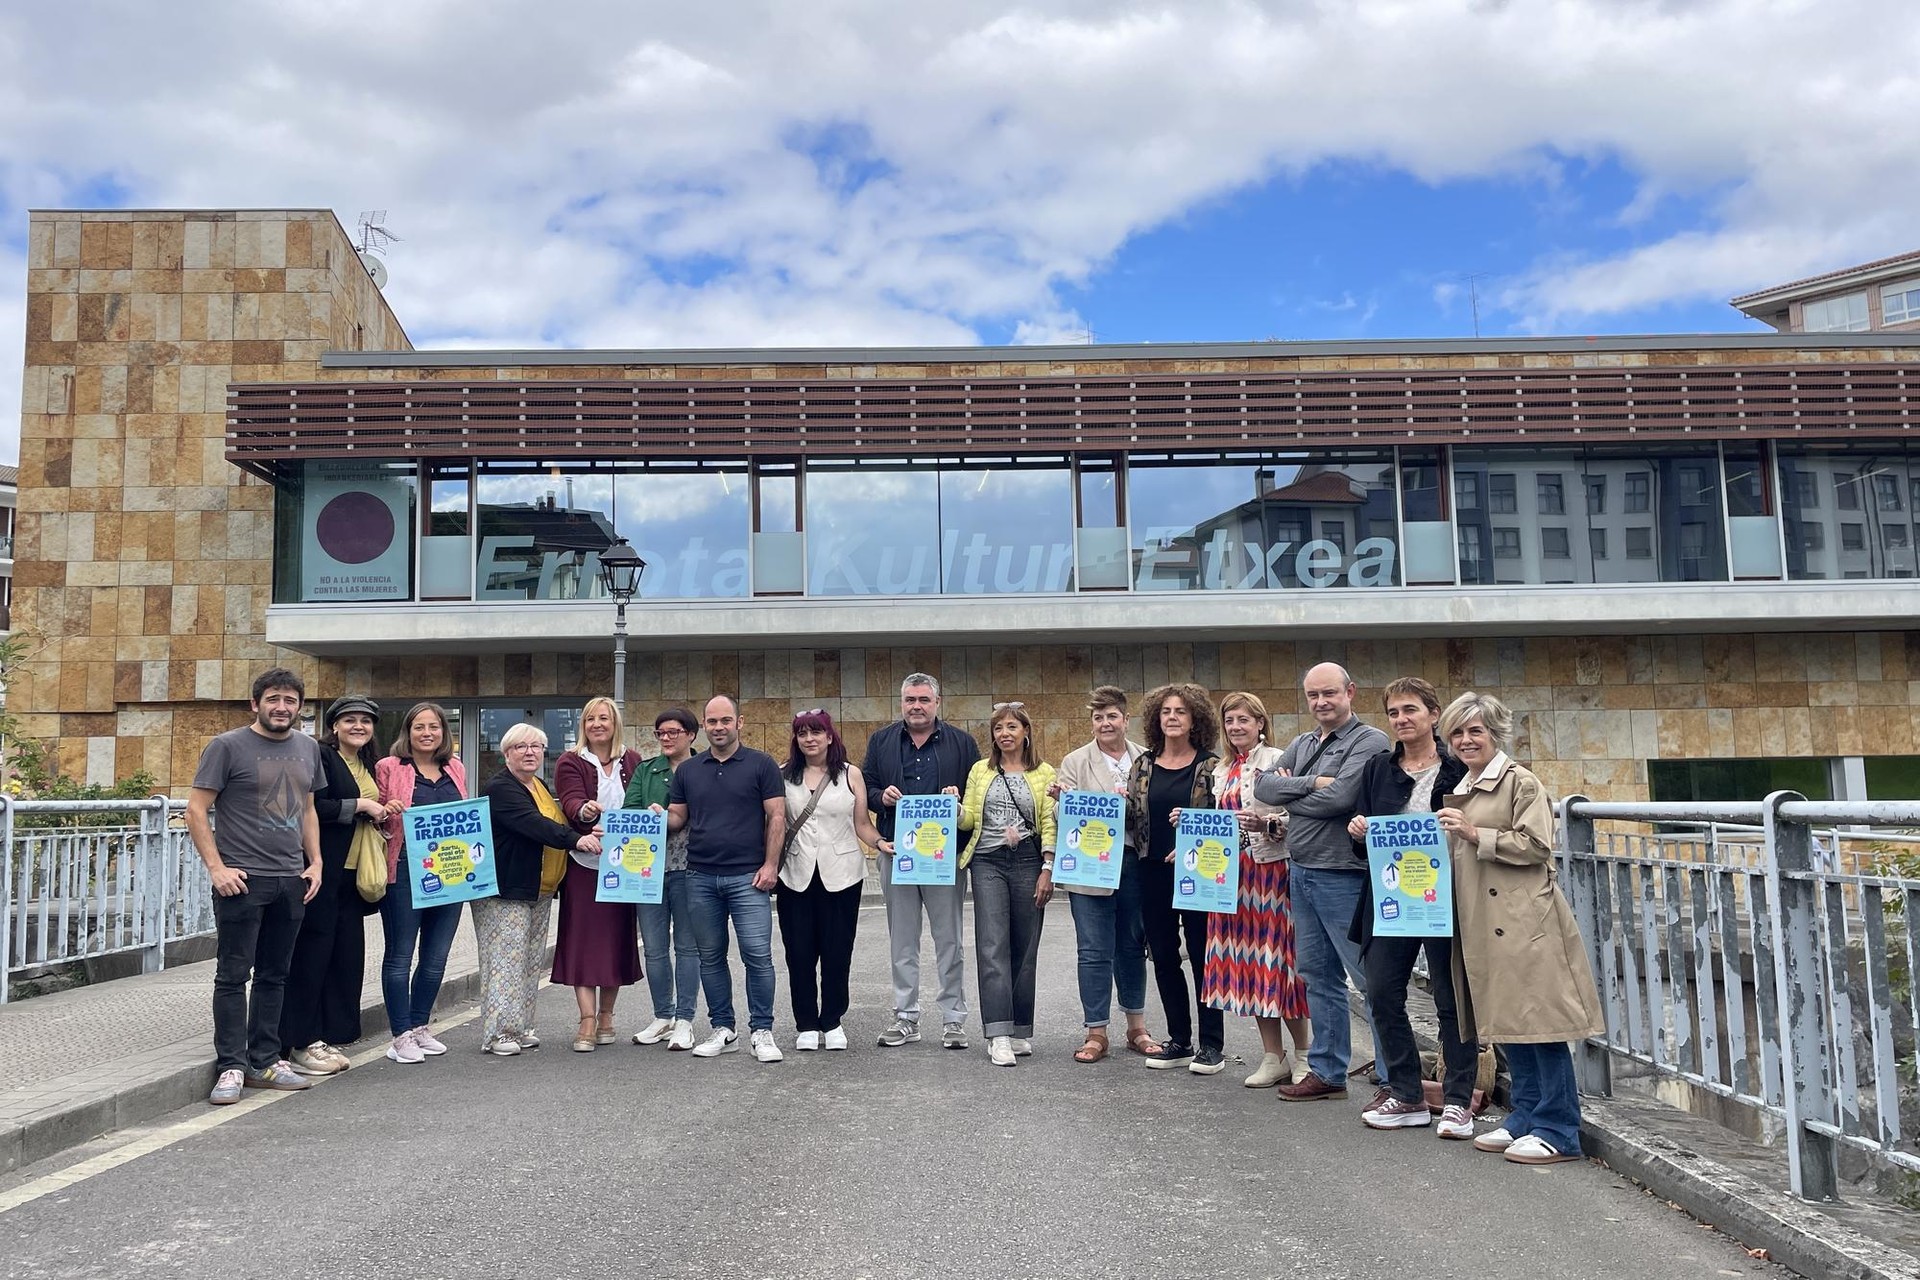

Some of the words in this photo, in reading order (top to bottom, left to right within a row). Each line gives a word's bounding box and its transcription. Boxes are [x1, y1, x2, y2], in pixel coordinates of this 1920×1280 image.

[810, 529, 1073, 595] Kultur
[1136, 526, 1396, 591] Etxea
[320, 576, 331, 584] NO
[333, 576, 338, 584] A
[341, 576, 350, 584] LA
[351, 575, 392, 584] VIOLENCIA
[314, 586, 343, 595] CONTRA
[345, 586, 360, 594] LAS
[361, 585, 398, 594] MUJERES
[901, 799, 952, 809] 2.500€
[1065, 794, 1119, 808] 2.500€
[901, 809, 951, 819] IRABAZI
[1064, 805, 1119, 819] IRABAZI
[414, 809, 480, 829] 2.500€
[1181, 813, 1233, 826] 2.500€
[415, 822, 482, 841] IRABAZI
[606, 824, 661, 835] IRABAZI
[1181, 825, 1233, 837] IRABAZI
[1370, 819, 1437, 835] 2.500€
[1372, 833, 1439, 848] IRABAZI
